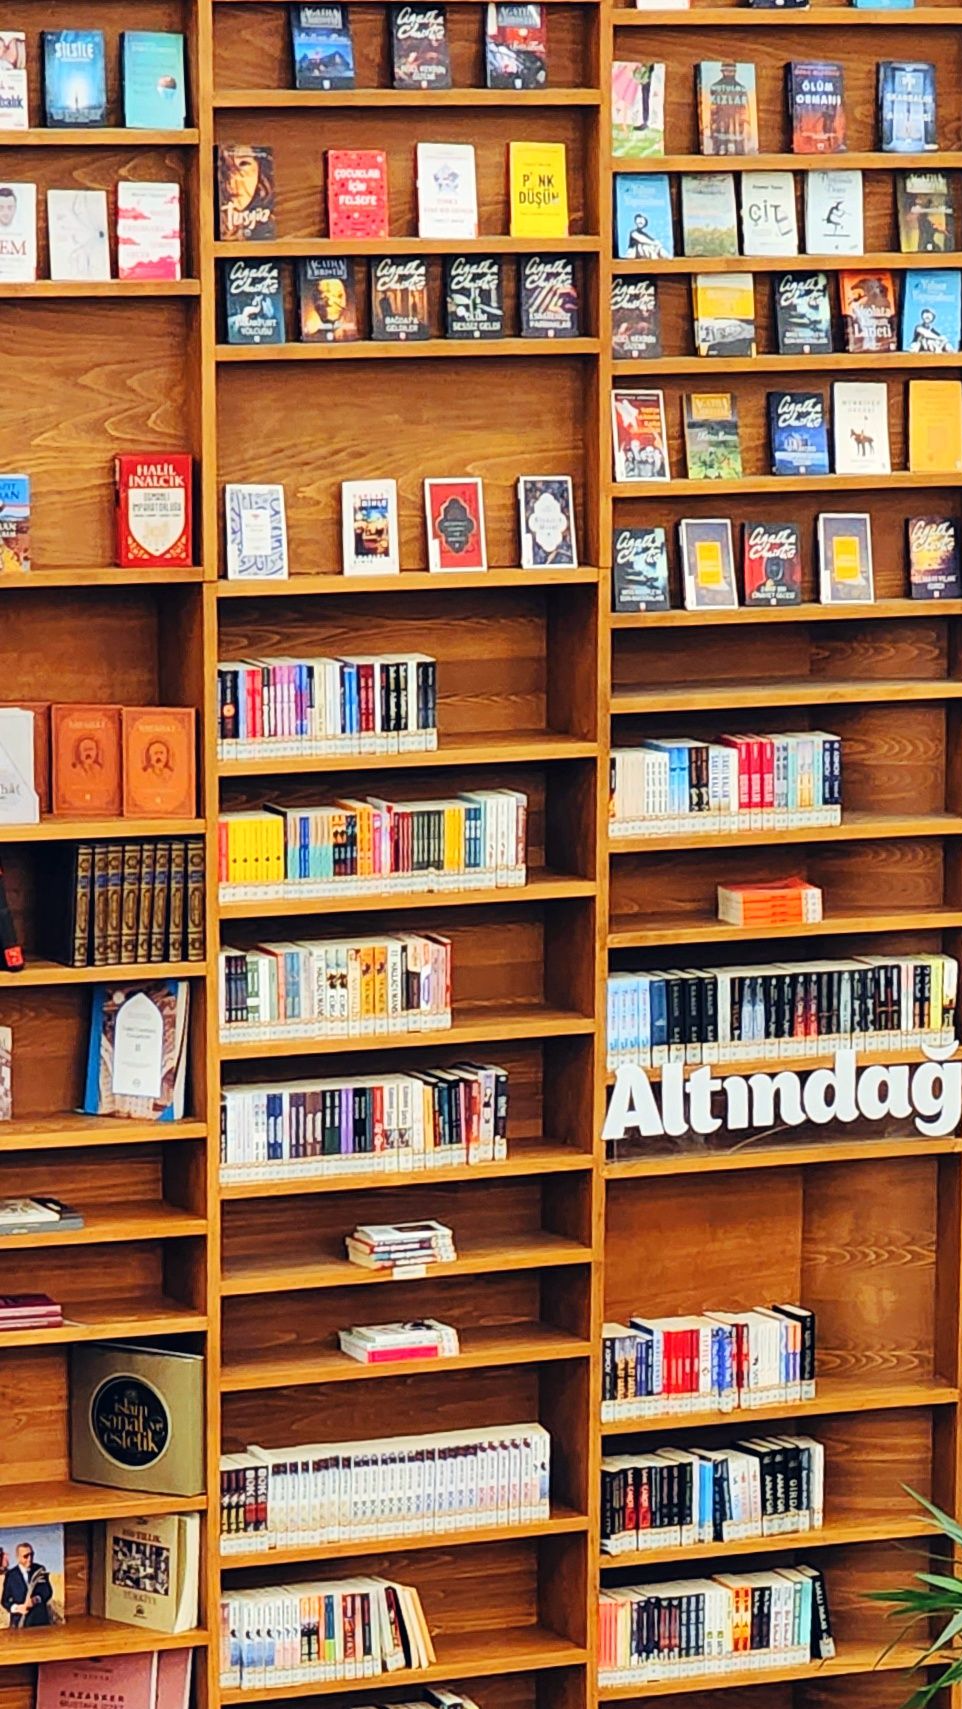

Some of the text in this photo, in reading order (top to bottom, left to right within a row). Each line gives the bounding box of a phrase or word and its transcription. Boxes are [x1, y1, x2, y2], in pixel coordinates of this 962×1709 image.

[136, 462, 177, 476] HALİL
[128, 474, 185, 487] İNALCIK
[602, 1040, 962, 1140] Altındağ
